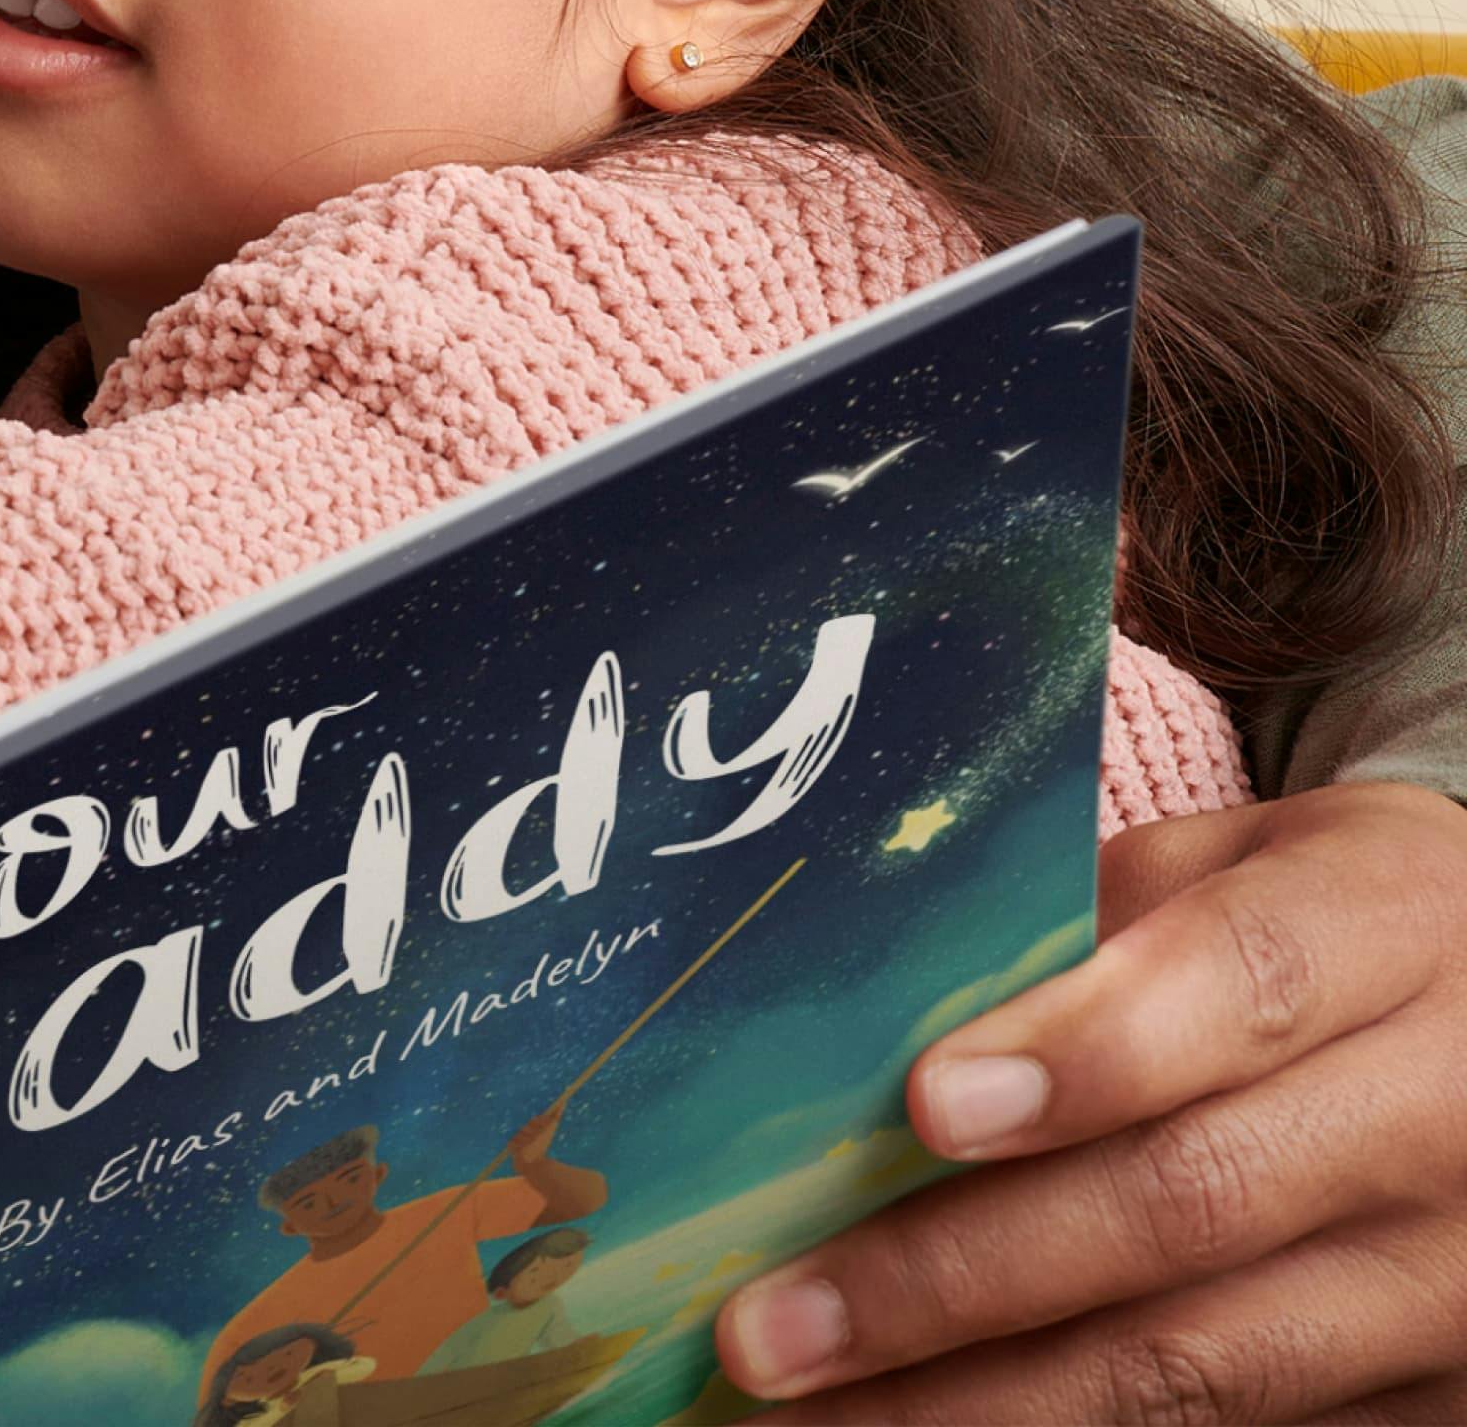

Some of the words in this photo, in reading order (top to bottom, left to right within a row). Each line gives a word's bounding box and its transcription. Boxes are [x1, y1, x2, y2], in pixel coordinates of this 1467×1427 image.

[88, 1112, 243, 1204] Elias
[264, 1030, 387, 1123] and
[398, 918, 661, 1062] Madelyn
